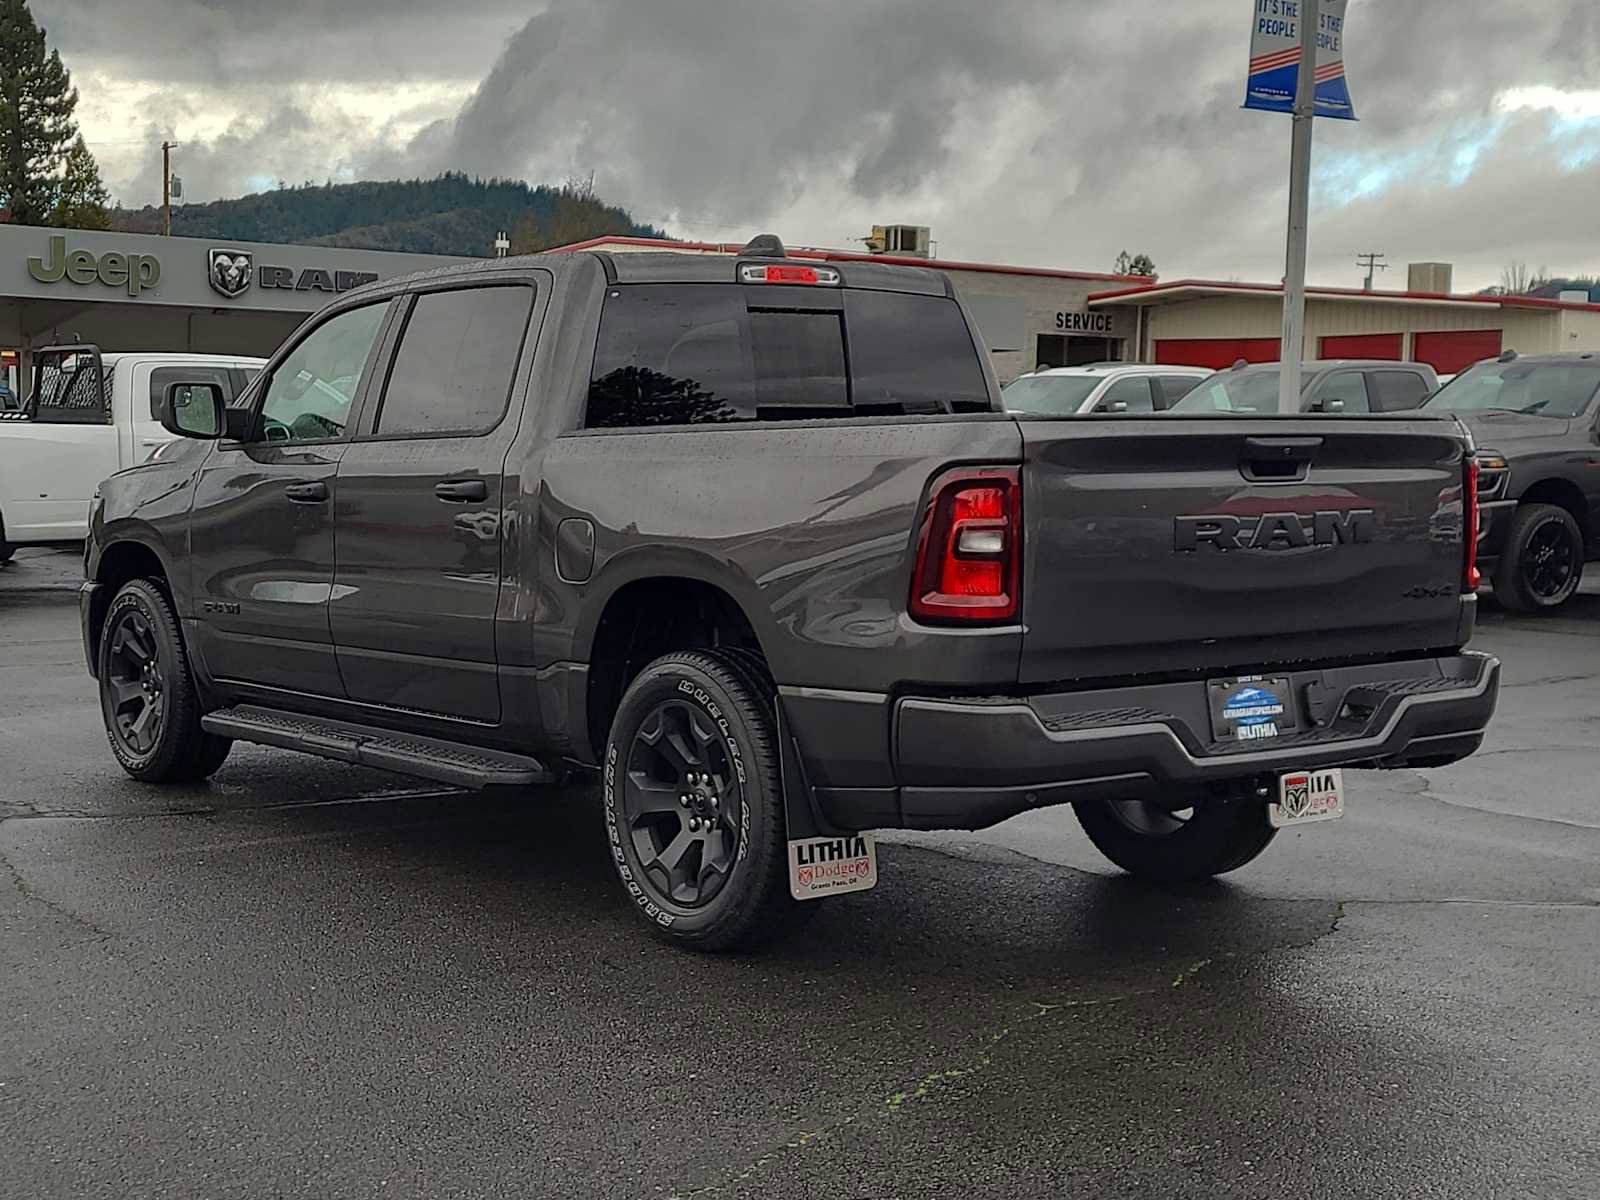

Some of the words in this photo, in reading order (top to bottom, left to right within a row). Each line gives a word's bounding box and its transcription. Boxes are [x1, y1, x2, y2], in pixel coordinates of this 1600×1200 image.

[1258, 0, 1280, 14] IT'S
[1281, 1, 1298, 18] THE
[1258, 18, 1296, 38] PEOPLE
[1316, 32, 1339, 52] EOPLE
[27, 235, 162, 297] Jeep
[259, 264, 379, 293] RAM
[1056, 311, 1112, 332] SERVICE
[1173, 508, 1374, 552] RAM
[1247, 722, 1279, 739] LITHIA
[604, 743, 676, 927] BRIDGESTONE
[797, 837, 868, 865] LITHIA
[815, 863, 855, 878] Dodge
